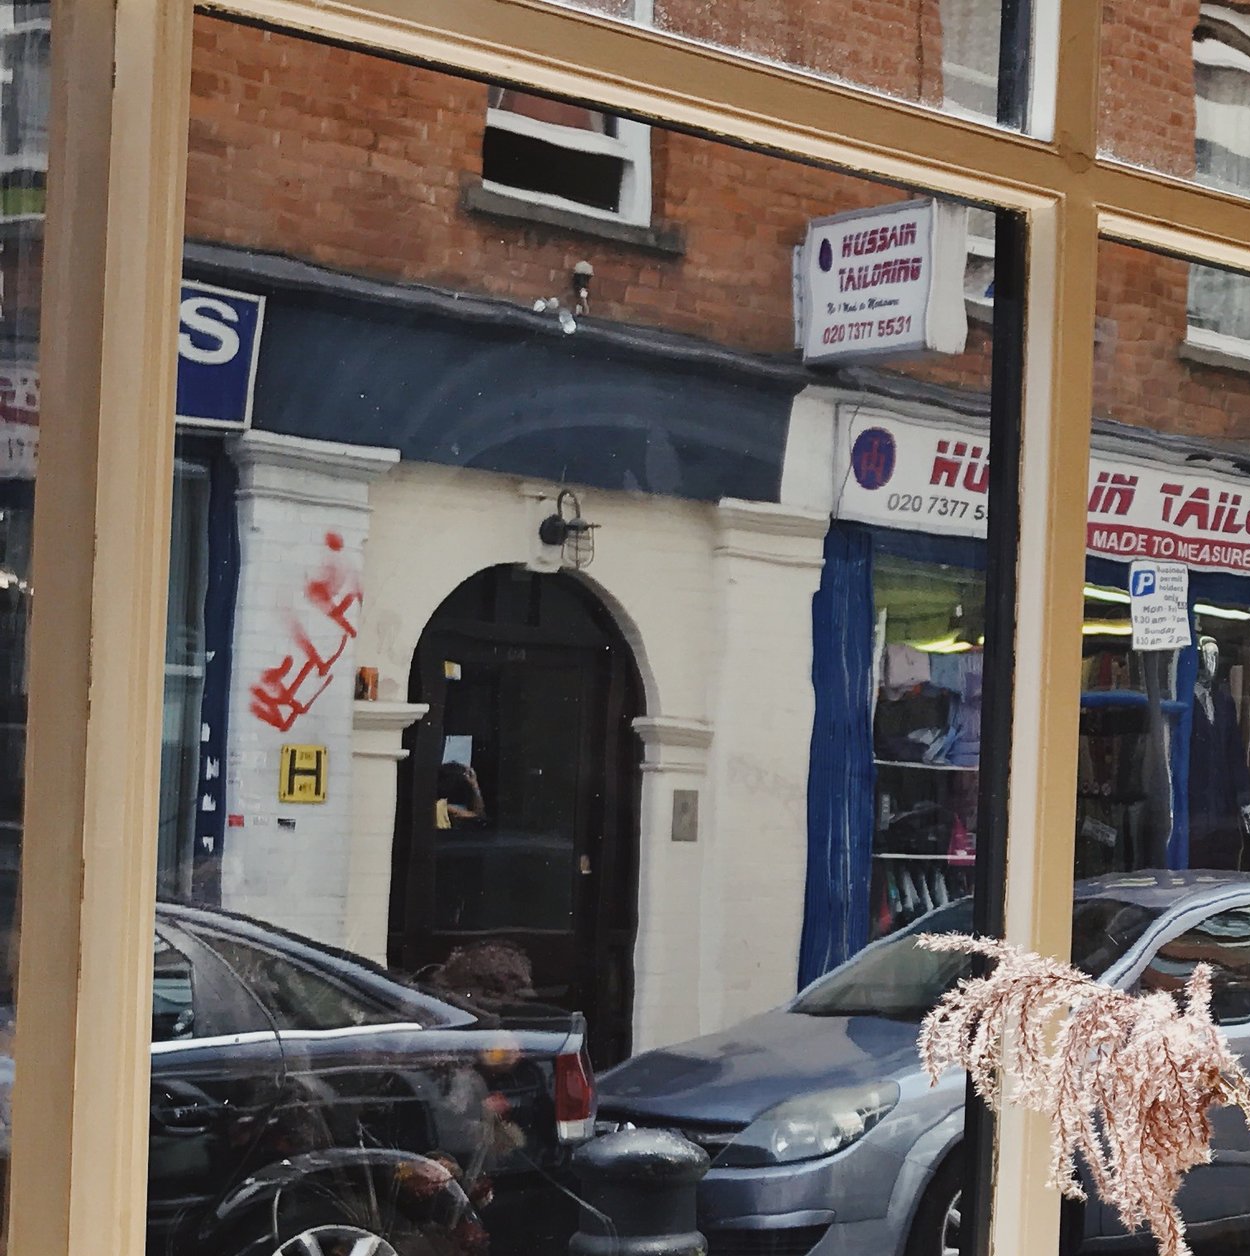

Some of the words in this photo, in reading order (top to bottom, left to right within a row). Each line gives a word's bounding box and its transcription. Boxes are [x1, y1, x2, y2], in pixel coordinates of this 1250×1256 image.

[842, 222, 917, 257] HUSSAIN
[838, 257, 922, 292] TAILORING
[823, 324, 845, 345] 020
[848, 321, 874, 341] 7377
[877, 316, 912, 338] 5531
[888, 493, 922, 512] 020
[927, 496, 970, 518] 7377
[1093, 530, 1147, 554] MADE
[1153, 536, 1174, 556] TO
[287, 749, 322, 796] H
